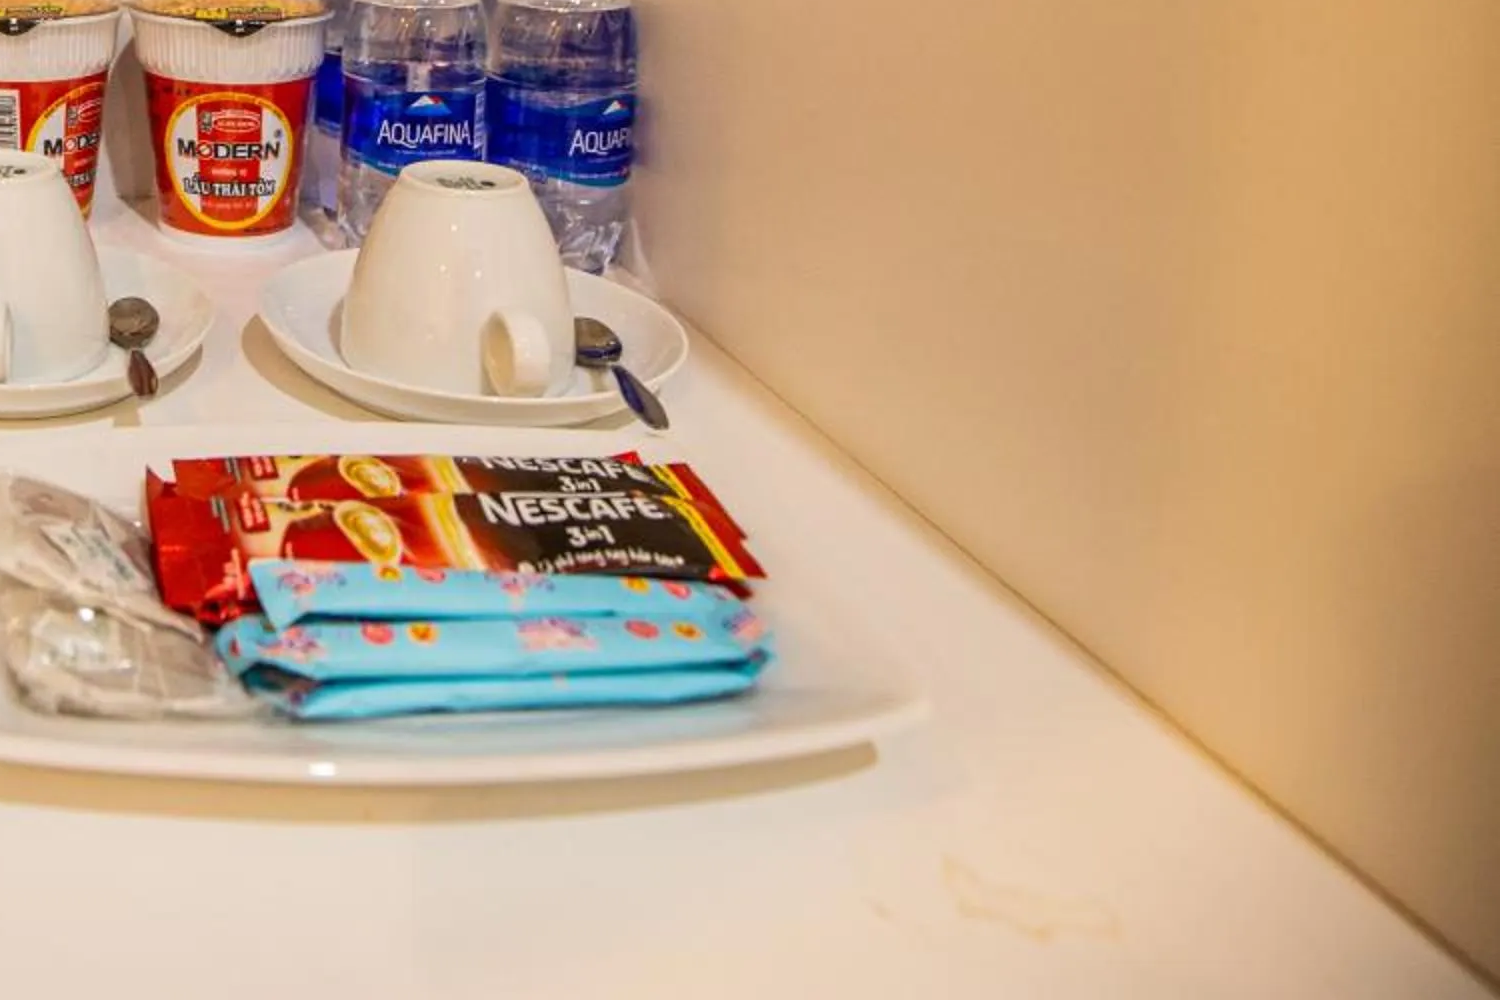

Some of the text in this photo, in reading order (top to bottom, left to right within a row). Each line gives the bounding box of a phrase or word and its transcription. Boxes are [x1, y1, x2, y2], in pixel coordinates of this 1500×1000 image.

[376, 119, 472, 149] AQUAFINA
[177, 137, 280, 160] MODERN
[560, 474, 601, 494] 3in1
[565, 525, 617, 547] 3in1
